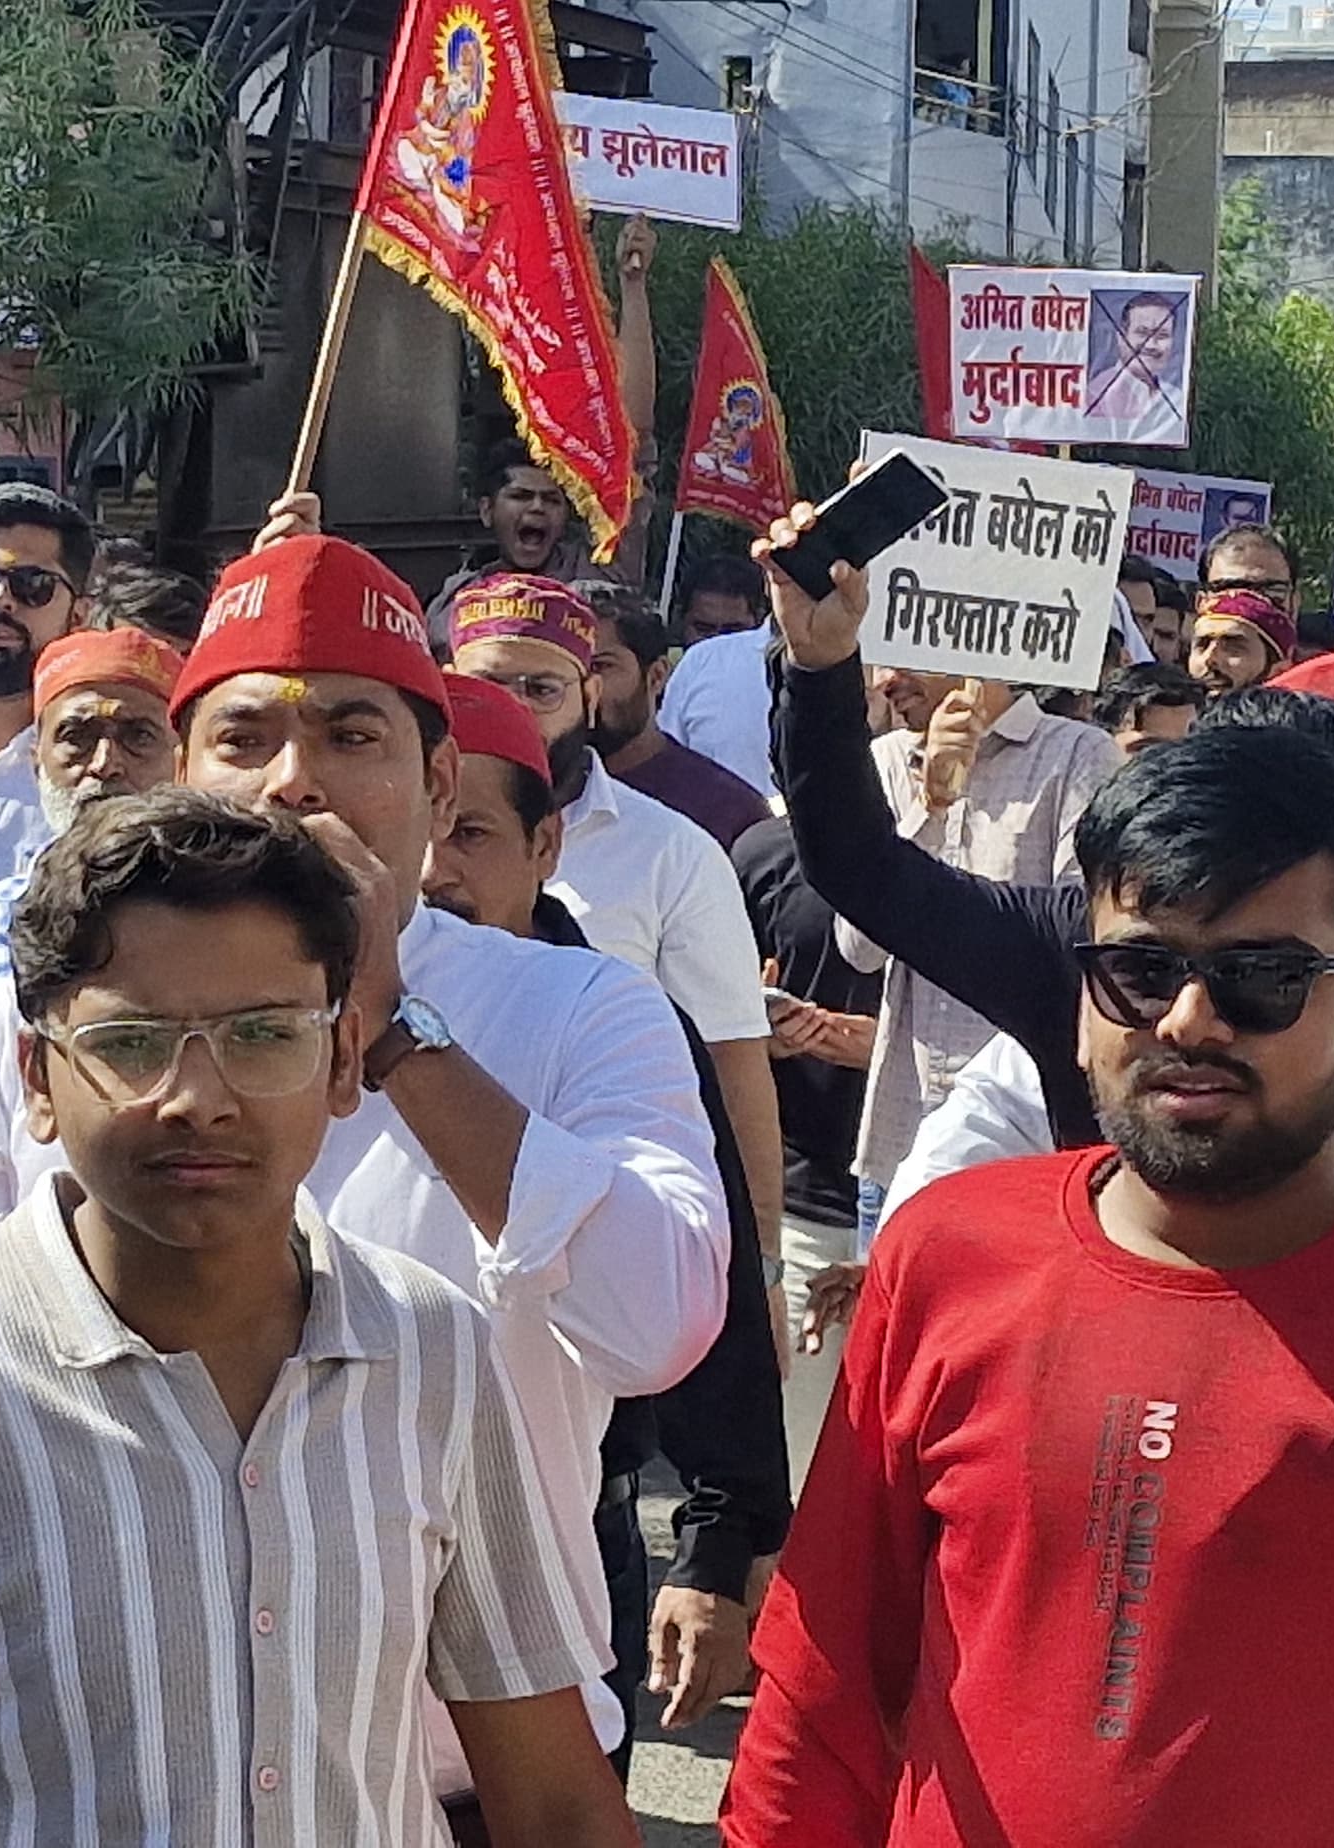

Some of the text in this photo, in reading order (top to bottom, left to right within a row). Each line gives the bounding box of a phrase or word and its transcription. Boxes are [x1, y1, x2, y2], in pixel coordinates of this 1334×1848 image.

[600, 122, 730, 179] झूलेलाल
[960, 283, 1089, 332] अमित बघेल
[960, 345, 1085, 424] मुर्दाबाद
[987, 477, 1070, 560] बघेल
[1071, 489, 1117, 566] को
[883, 567, 1082, 664] गिरफ्तार करो
[1138, 1399, 1179, 1461] NO
[1094, 1471, 1165, 1742] COMPLAINTS
